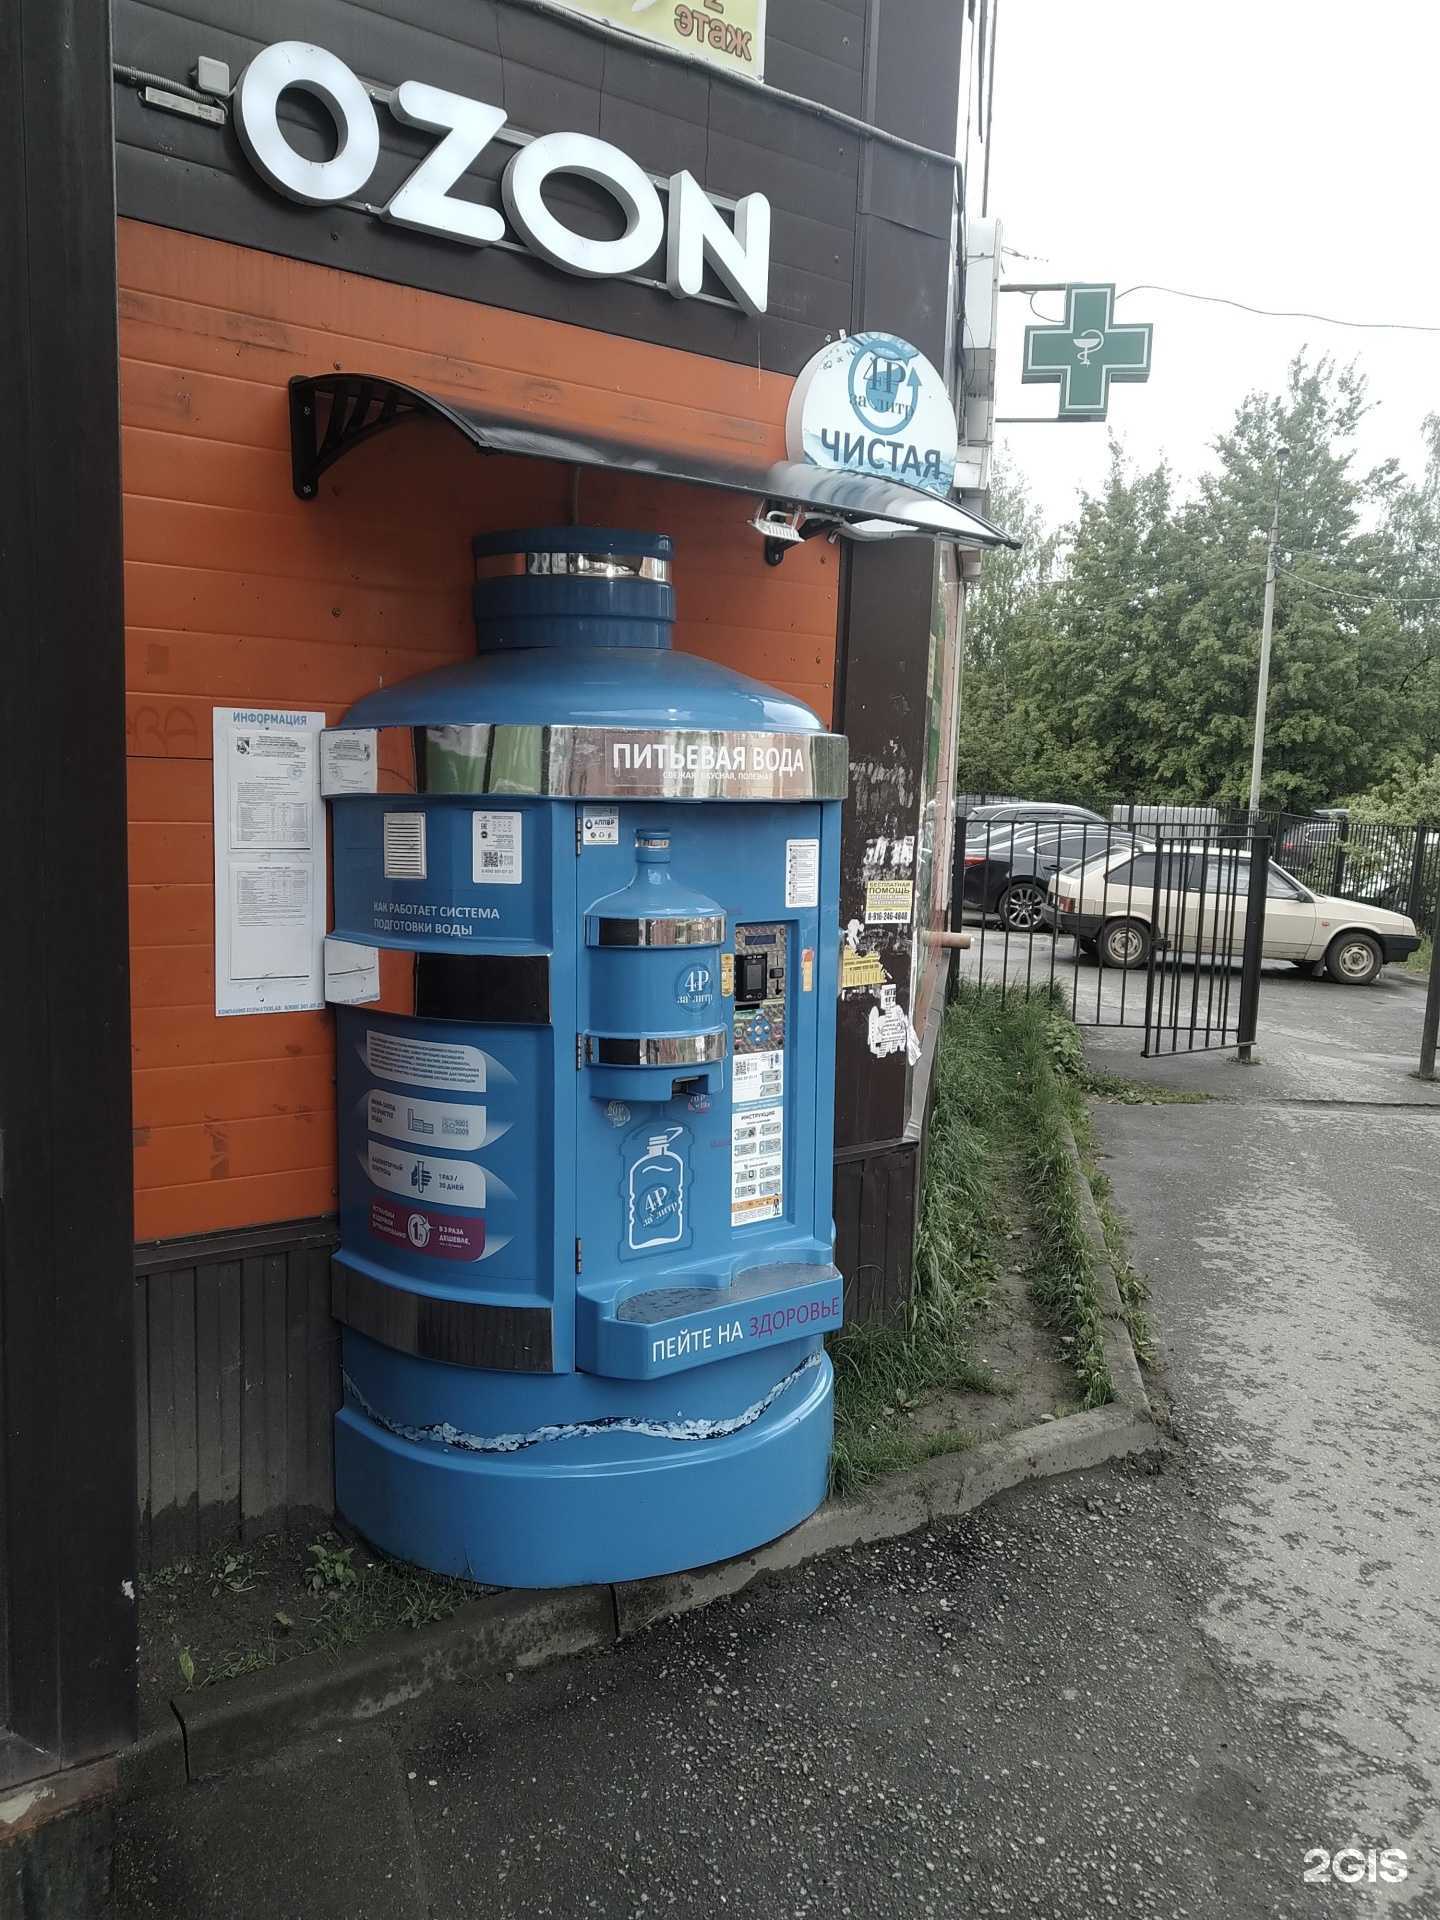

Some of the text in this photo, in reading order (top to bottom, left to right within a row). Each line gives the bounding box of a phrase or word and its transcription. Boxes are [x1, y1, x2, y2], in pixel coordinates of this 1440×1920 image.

[674, 4, 752, 61] этаж
[236, 41, 771, 313] OZON
[821, 428, 941, 480] ЧИСТАЯ
[233, 711, 307, 726] ИНФОРМАЦИЯ
[613, 743, 804, 777] ПИТЬЕВАЯ ВОДА
[869, 887, 911, 895] ПОМОЩЬ
[373, 902, 500, 919] КАК РАБОТАЕТ СИСТЕМА
[374, 919, 473, 936] ПОДГОТОВКИ ВОДЫ
[652, 1295, 840, 1362] ПЕЙТЕ НА ЗДОРОВЬЕ
